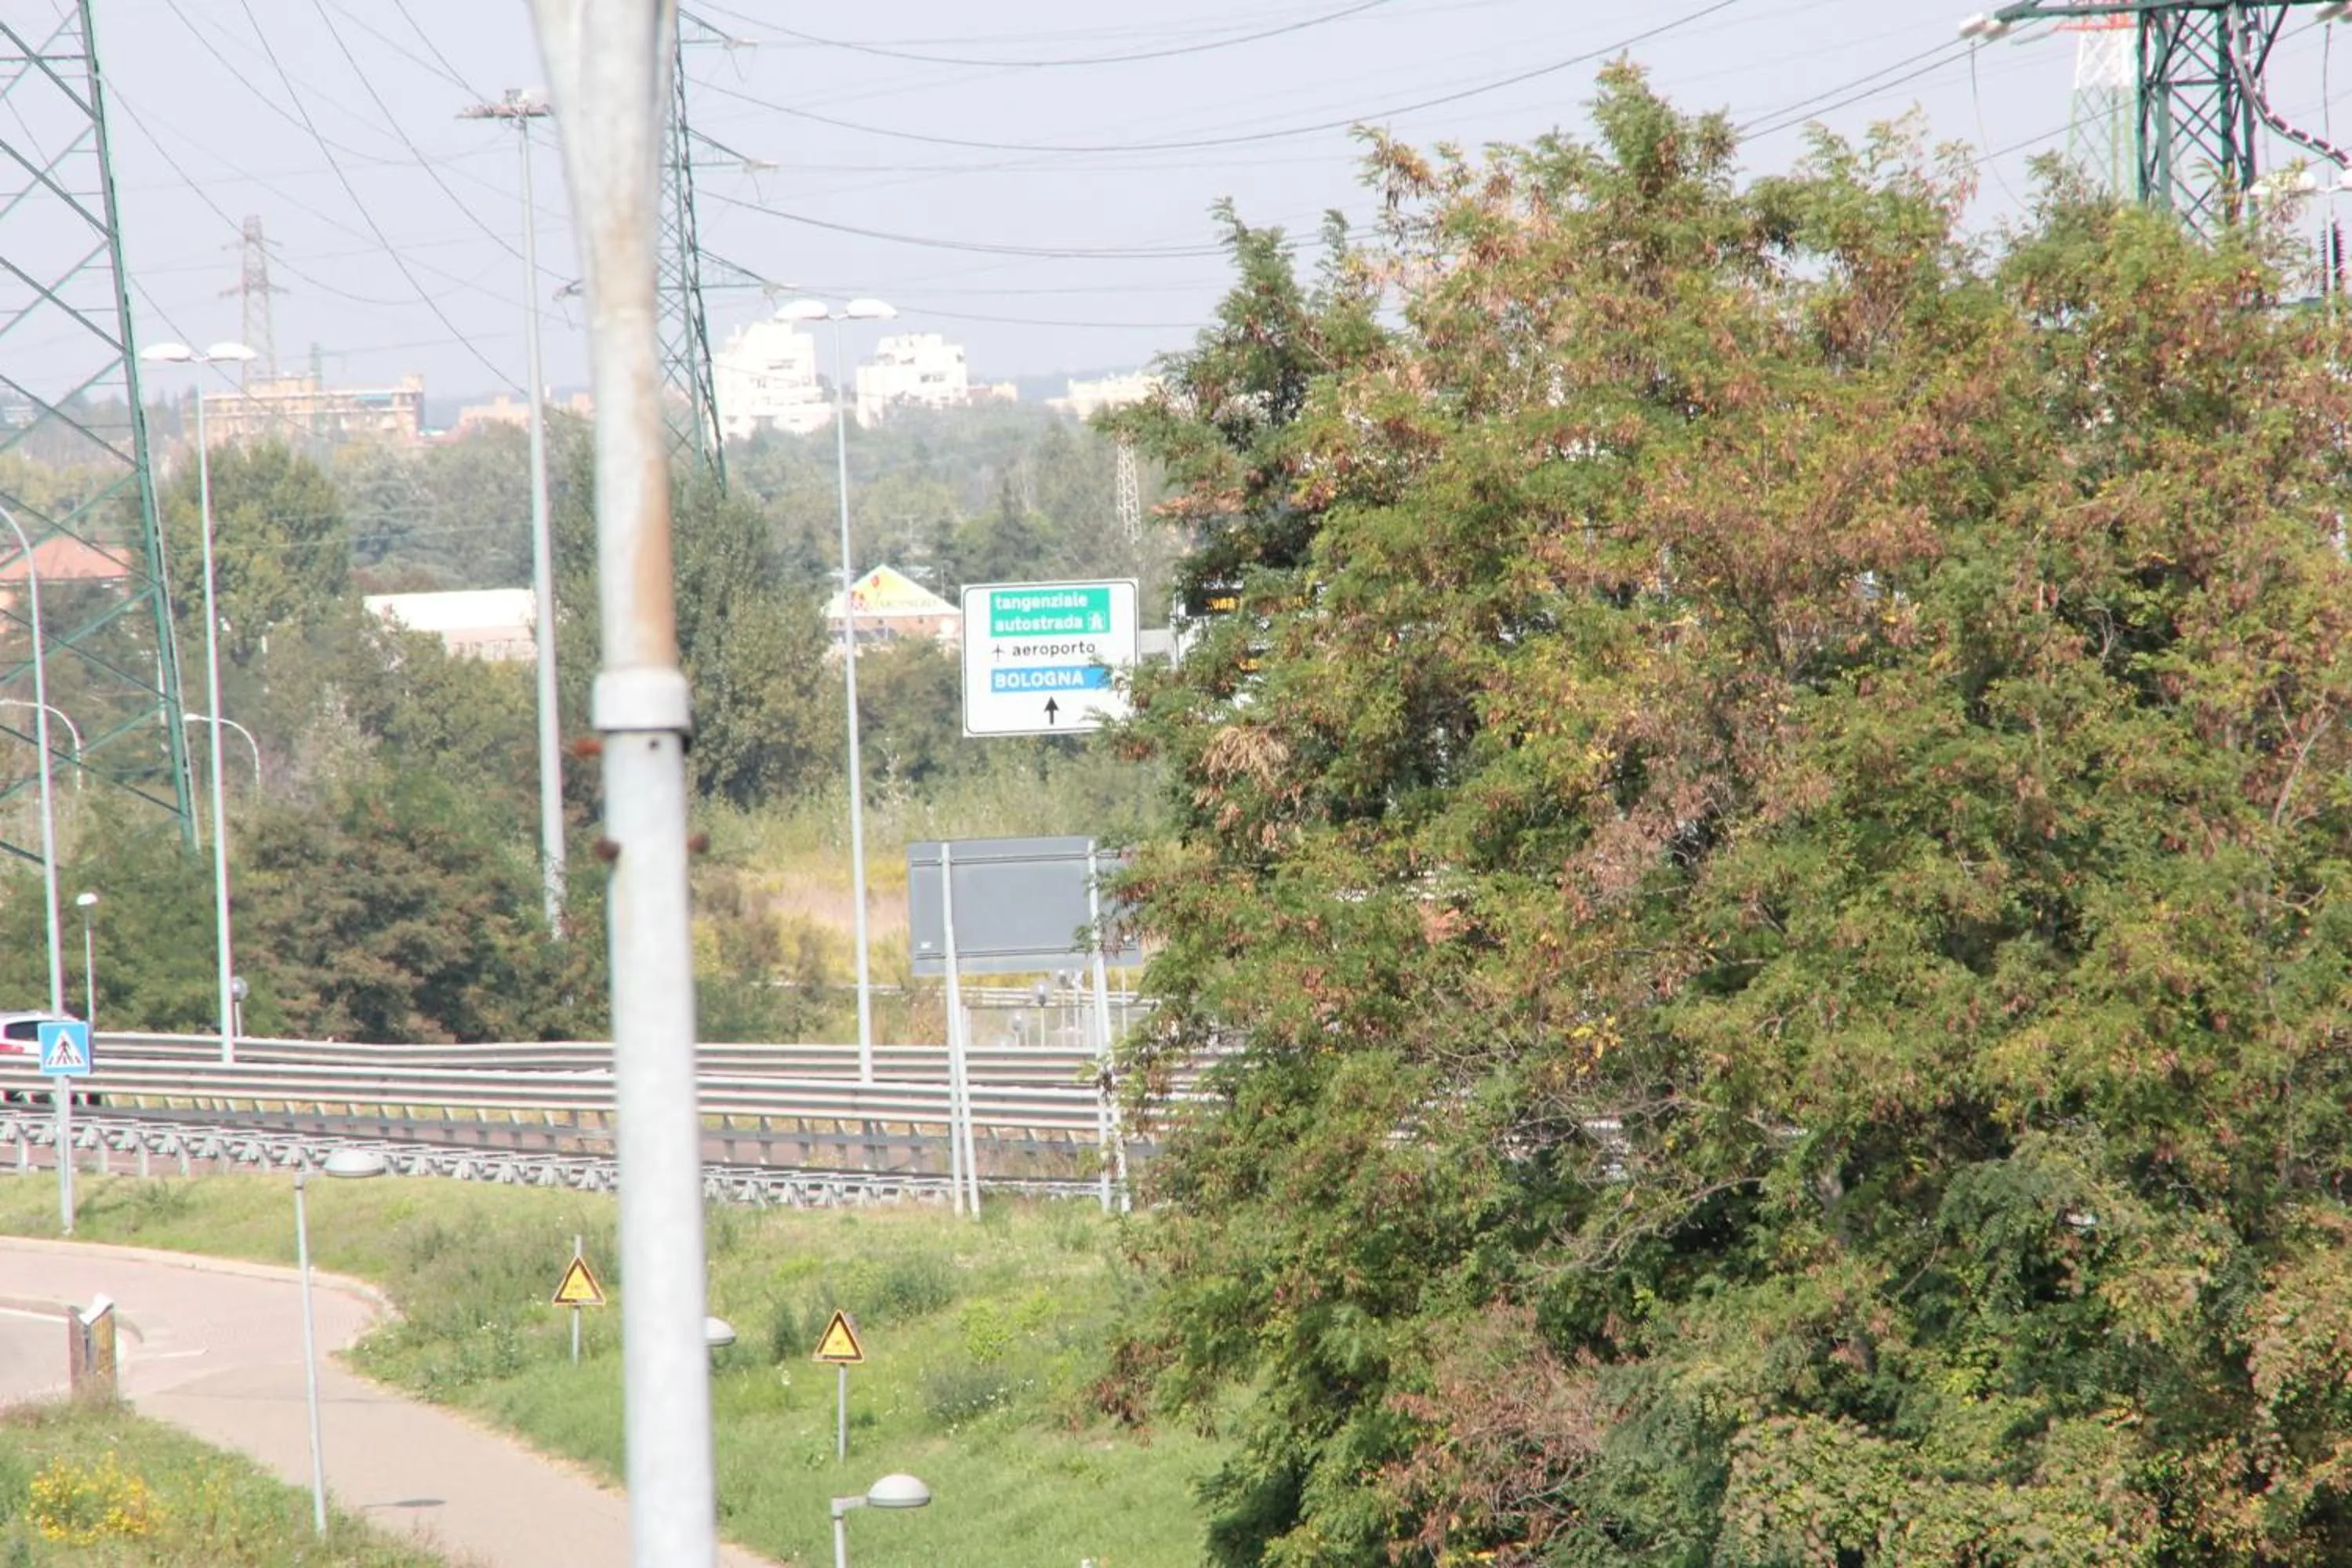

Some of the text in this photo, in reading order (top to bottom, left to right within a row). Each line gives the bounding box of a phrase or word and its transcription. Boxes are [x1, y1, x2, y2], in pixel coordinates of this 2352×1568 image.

[995, 592, 1088, 612] tangenziale
[995, 615, 1083, 633] autostrada
[1012, 641, 1096, 657] aeroporto
[994, 670, 1084, 688] BOLOGNA
